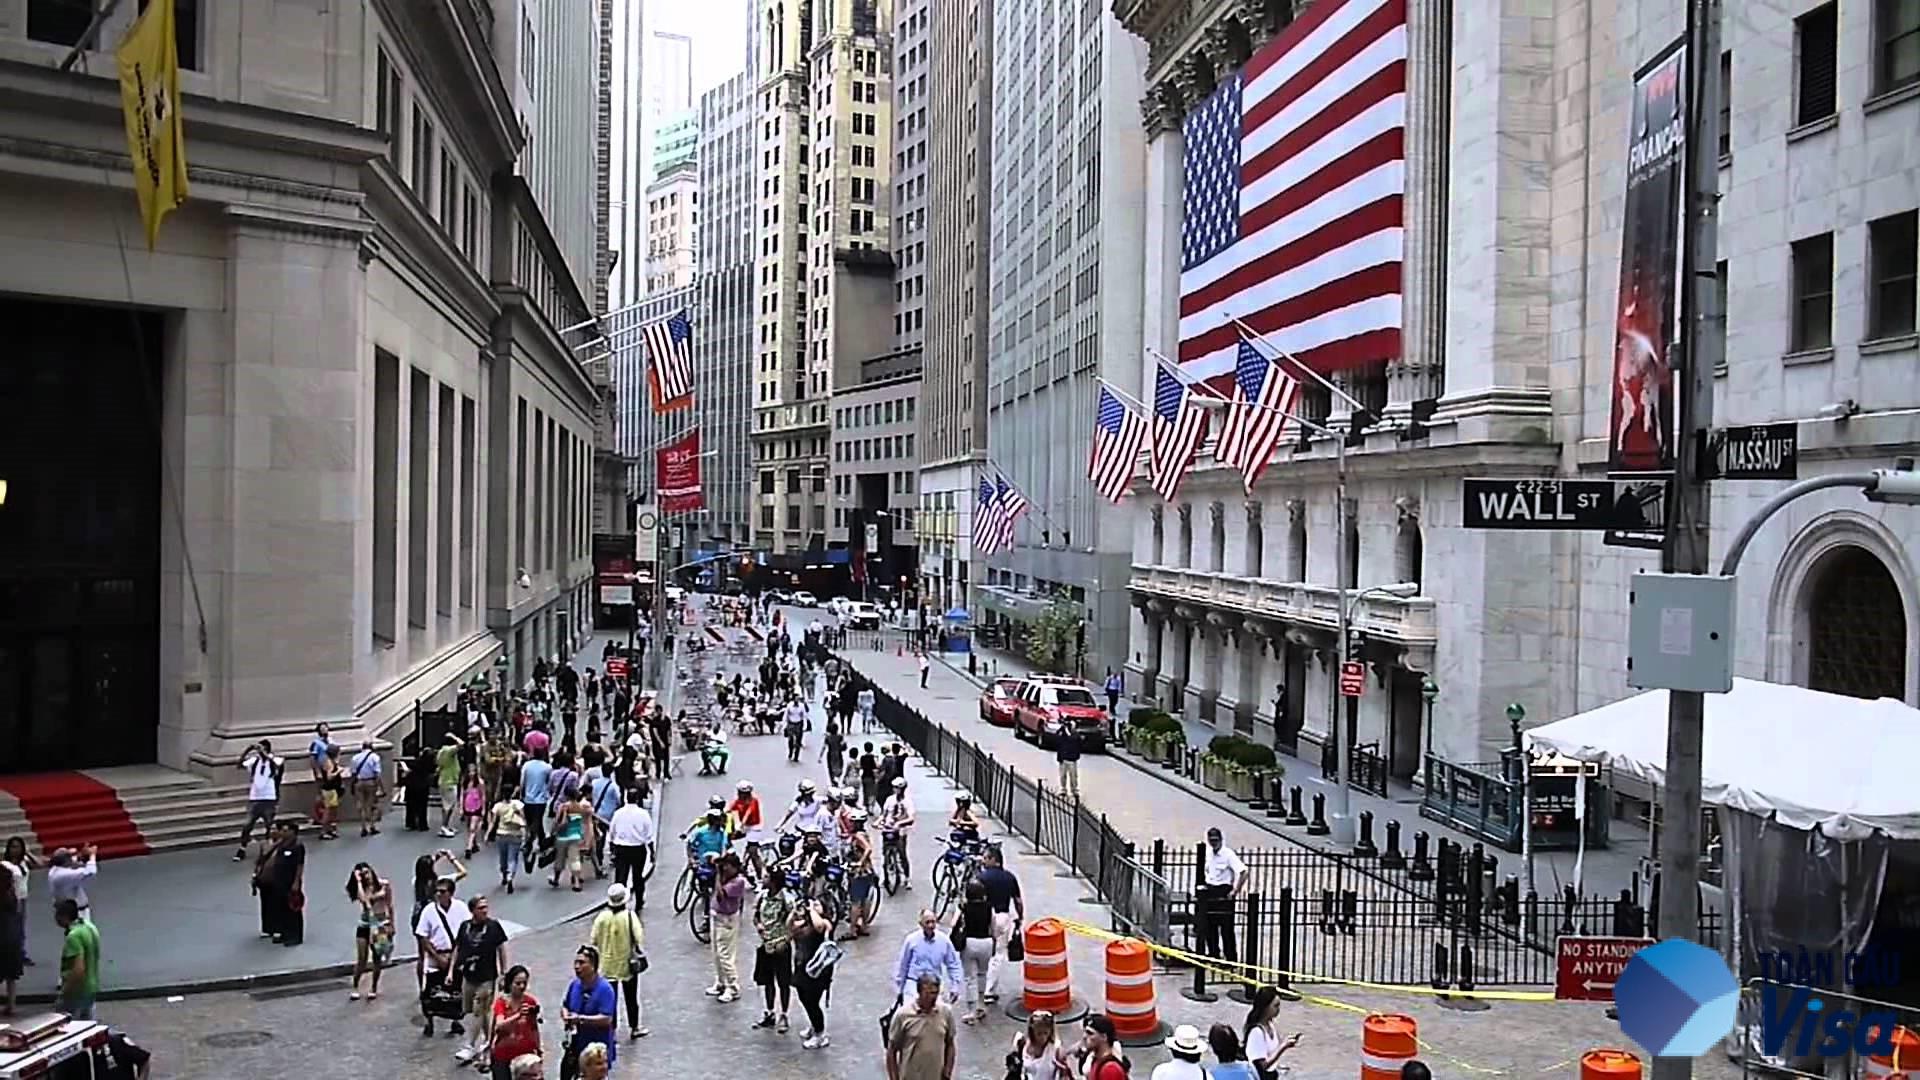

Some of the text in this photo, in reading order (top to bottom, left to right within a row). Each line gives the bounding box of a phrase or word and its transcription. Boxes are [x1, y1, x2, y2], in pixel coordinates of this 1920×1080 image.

[1728, 438, 1793, 470] NASSAU ST
[1527, 480, 1563, 494] 22-51
[1479, 492, 1601, 520] WALL ST
[1562, 943, 1581, 957] NO
